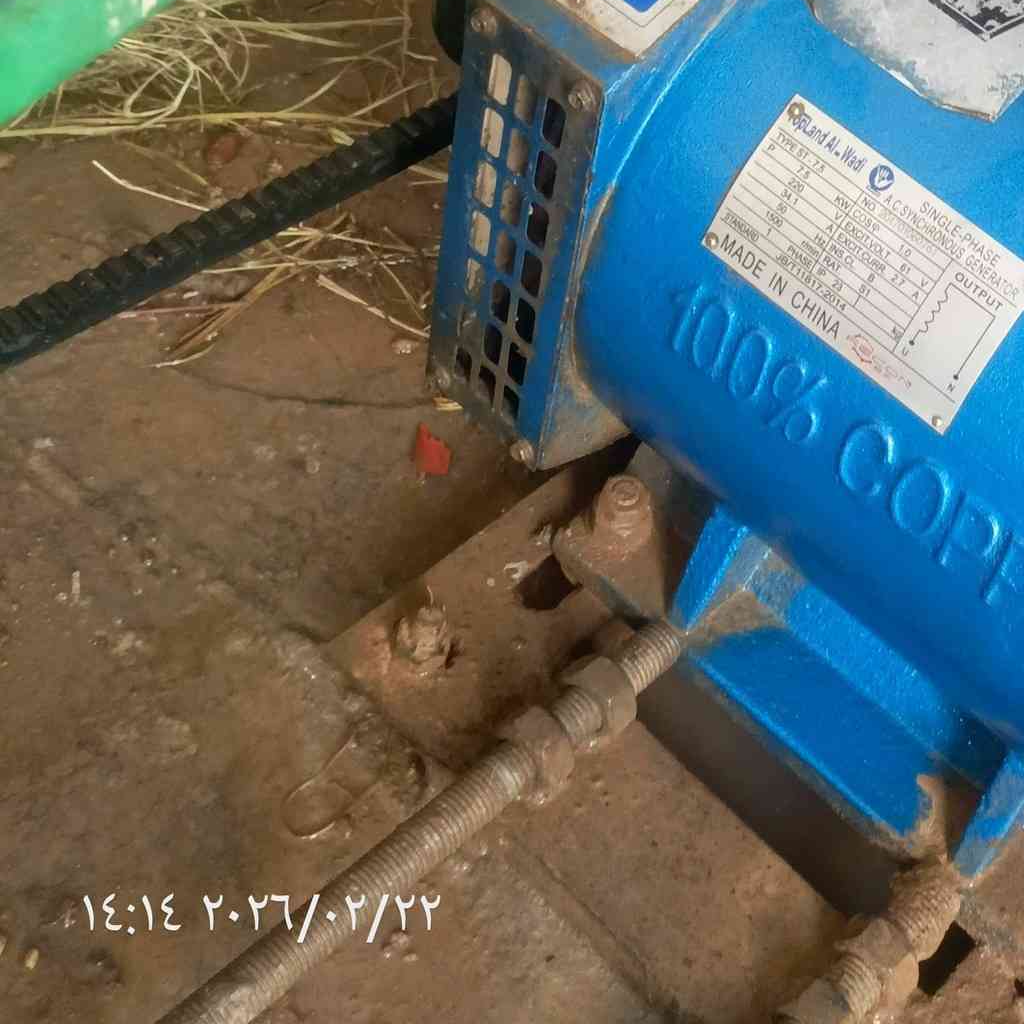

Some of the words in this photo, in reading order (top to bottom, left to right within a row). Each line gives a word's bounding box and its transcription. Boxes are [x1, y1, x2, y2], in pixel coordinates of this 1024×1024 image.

[777, 132, 797, 152] TYPE
[788, 178, 804, 192] 220
[833, 210, 843, 221] V
[834, 196, 851, 209] KW
[723, 213, 759, 241] STANDARD
[766, 211, 783, 227] 1500
[776, 203, 787, 214] 50
[813, 234, 825, 247] Hz
[825, 224, 833, 233] A
[920, 201, 1000, 267] SINGLE-PHASE
[787, 245, 812, 269] PHASE
[720, 234, 767, 279] MADE
[768, 272, 788, 296] IN
[789, 289, 841, 339] CHINA
[816, 267, 826, 276] IP
[832, 280, 843, 291] 23
[867, 273, 875, 282] B
[919, 277, 929, 288] V
[965, 255, 1019, 300] GENERATOR
[911, 289, 921, 300] A
[955, 272, 1003, 310] OUTPUT
[902, 347, 909, 356] U
[673, 285, 829, 443] 100%
[947, 384, 955, 392] N
